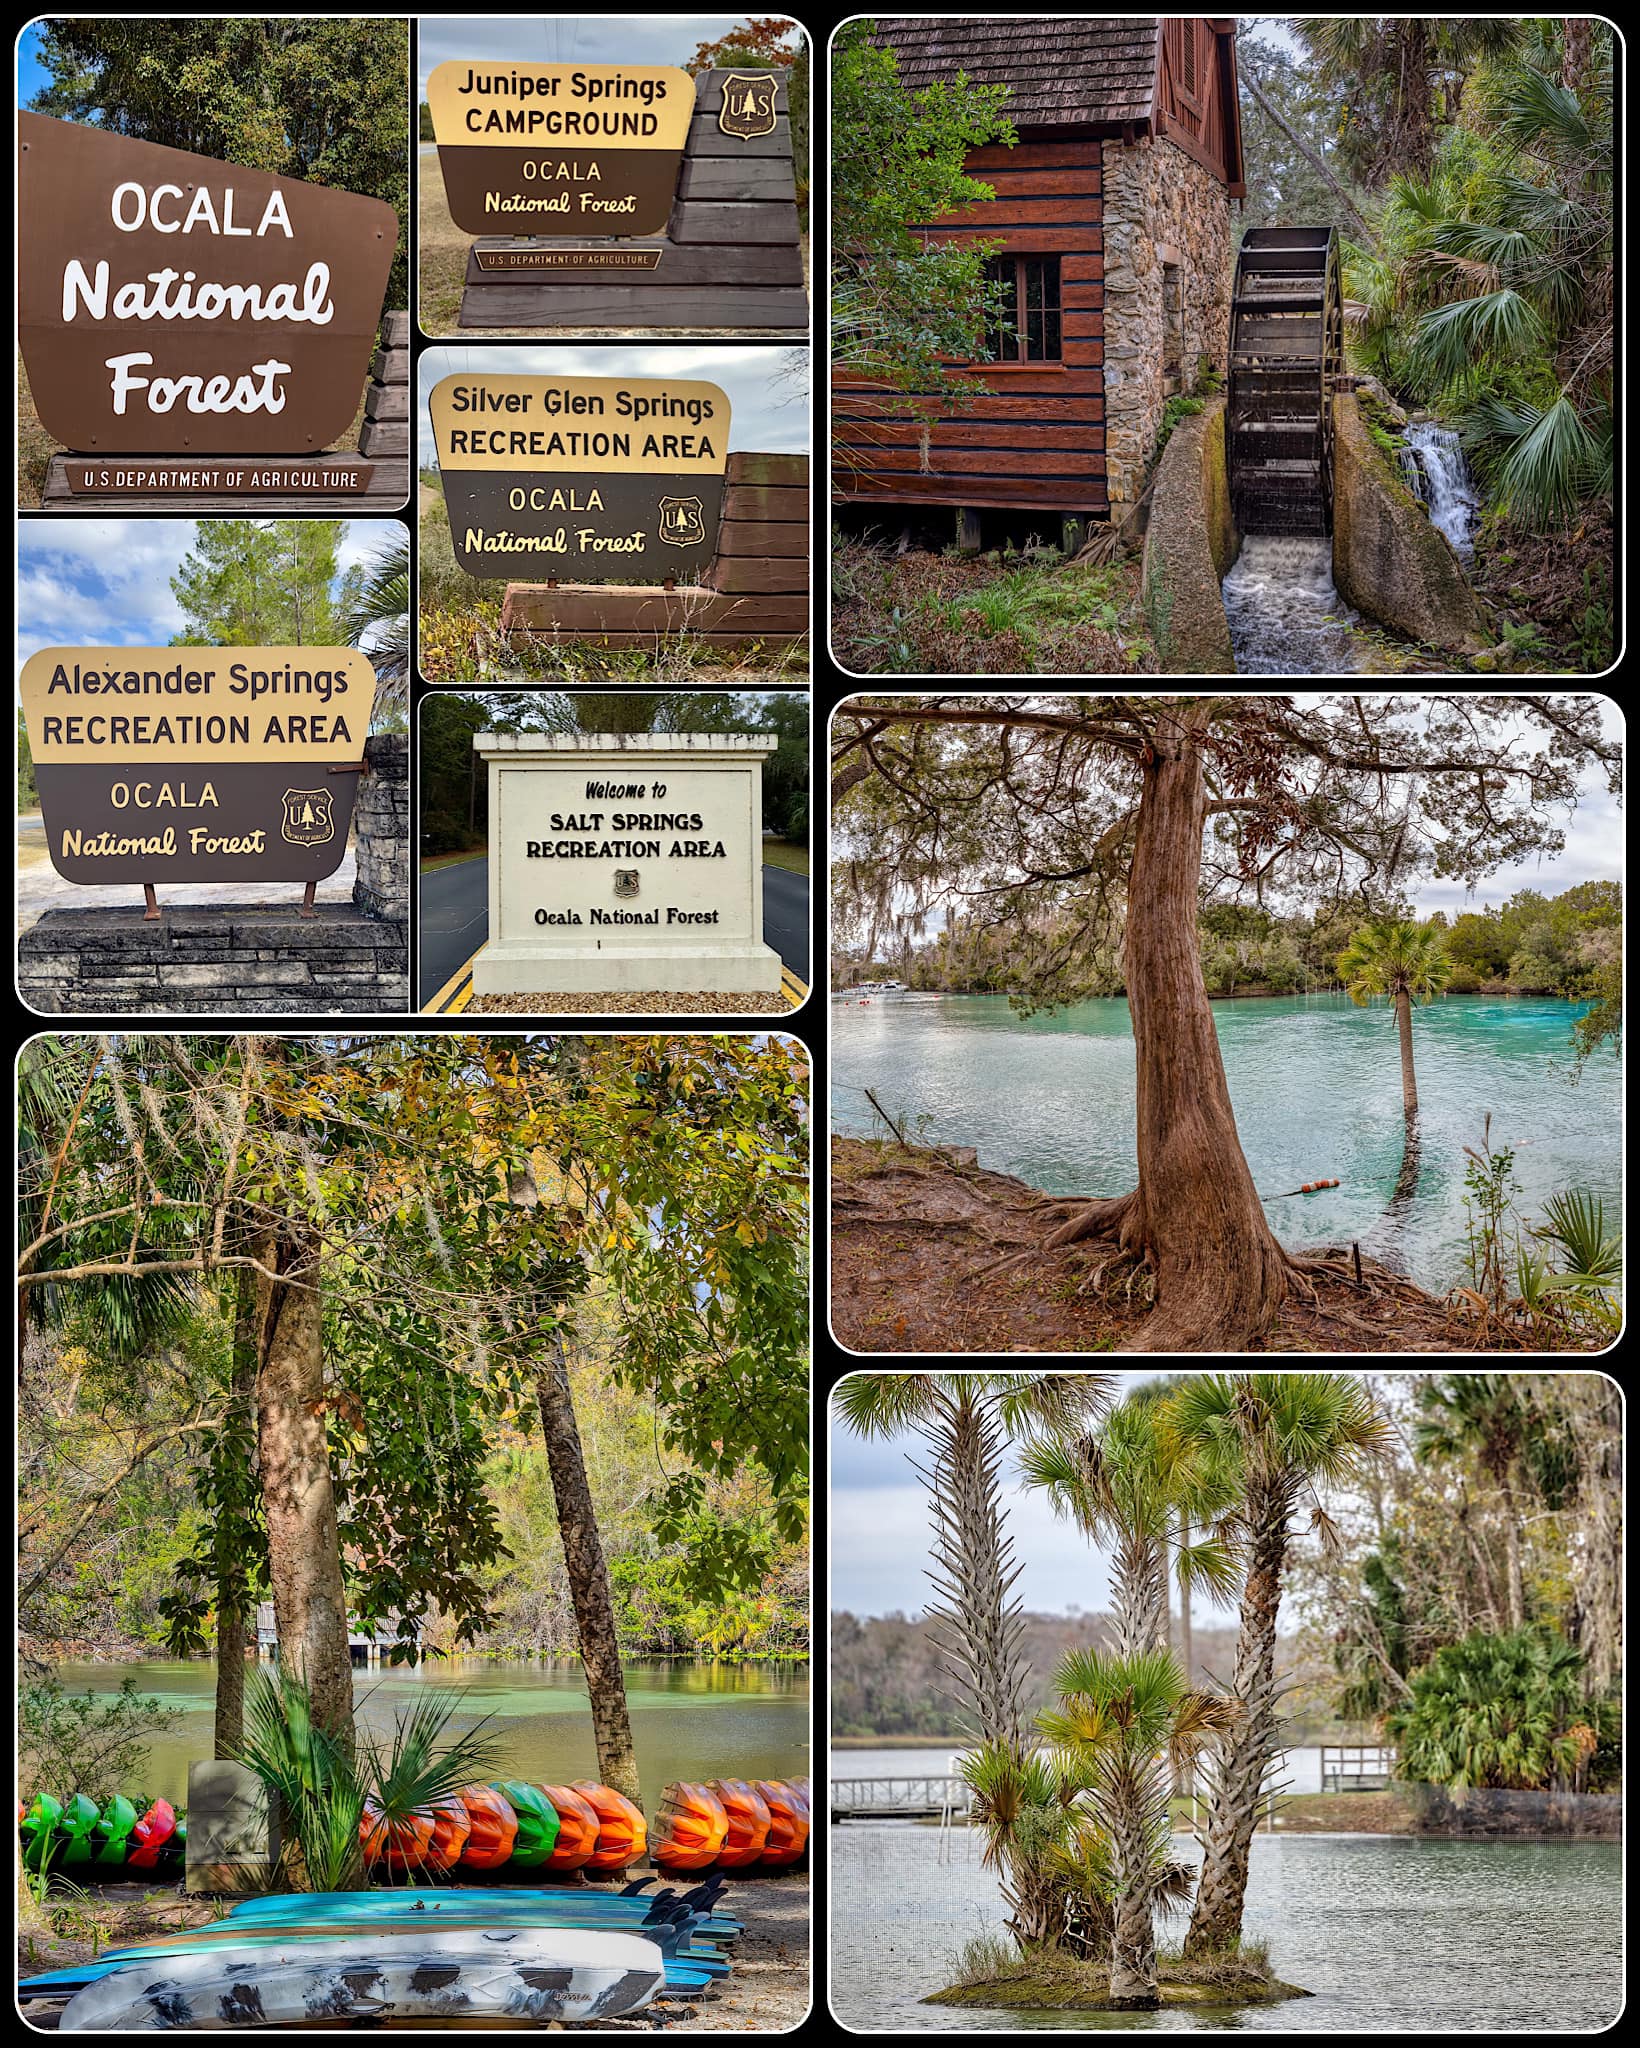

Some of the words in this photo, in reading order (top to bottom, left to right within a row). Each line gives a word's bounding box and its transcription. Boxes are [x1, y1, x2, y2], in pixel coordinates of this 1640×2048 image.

[458, 70, 561, 100] Juniper
[571, 73, 666, 105] Springs
[466, 109, 657, 135] CAMPGROUND
[524, 161, 600, 180] OCALA
[112, 182, 293, 237] OCALA
[486, 192, 570, 212] National
[579, 193, 636, 212] Forest
[511, 256, 568, 264] DEPARTMENT
[573, 256, 584, 264] OF
[588, 256, 648, 264] AGRICULTURE
[63, 260, 333, 324] National
[106, 352, 291, 414] Forest
[452, 387, 532, 412] Silver
[545, 389, 603, 414] Glen
[616, 391, 713, 425] Springs
[451, 430, 629, 456] RECREATION
[642, 435, 715, 458] AREA
[227, 472, 244, 486] OF
[251, 472, 357, 486] AGRICULTURE
[510, 488, 604, 510] OCALA
[466, 528, 567, 553] National
[578, 529, 645, 552] Forest
[48, 665, 215, 694] Alexander
[229, 664, 348, 703] Springs
[44, 716, 249, 744] RECREATION
[264, 716, 351, 743] AREA
[111, 783, 218, 808] OCALA
[586, 781, 645, 799] Welcome
[652, 782, 666, 798] to
[550, 814, 604, 831] SALT
[612, 814, 703, 831] SPRINGS
[63, 827, 176, 857] National
[190, 828, 265, 854] Forest
[527, 841, 660, 858] RECREATION
[668, 841, 726, 857] AREA
[535, 909, 582, 925] Ocala
[590, 909, 658, 924] National
[667, 908, 718, 924] Forest
